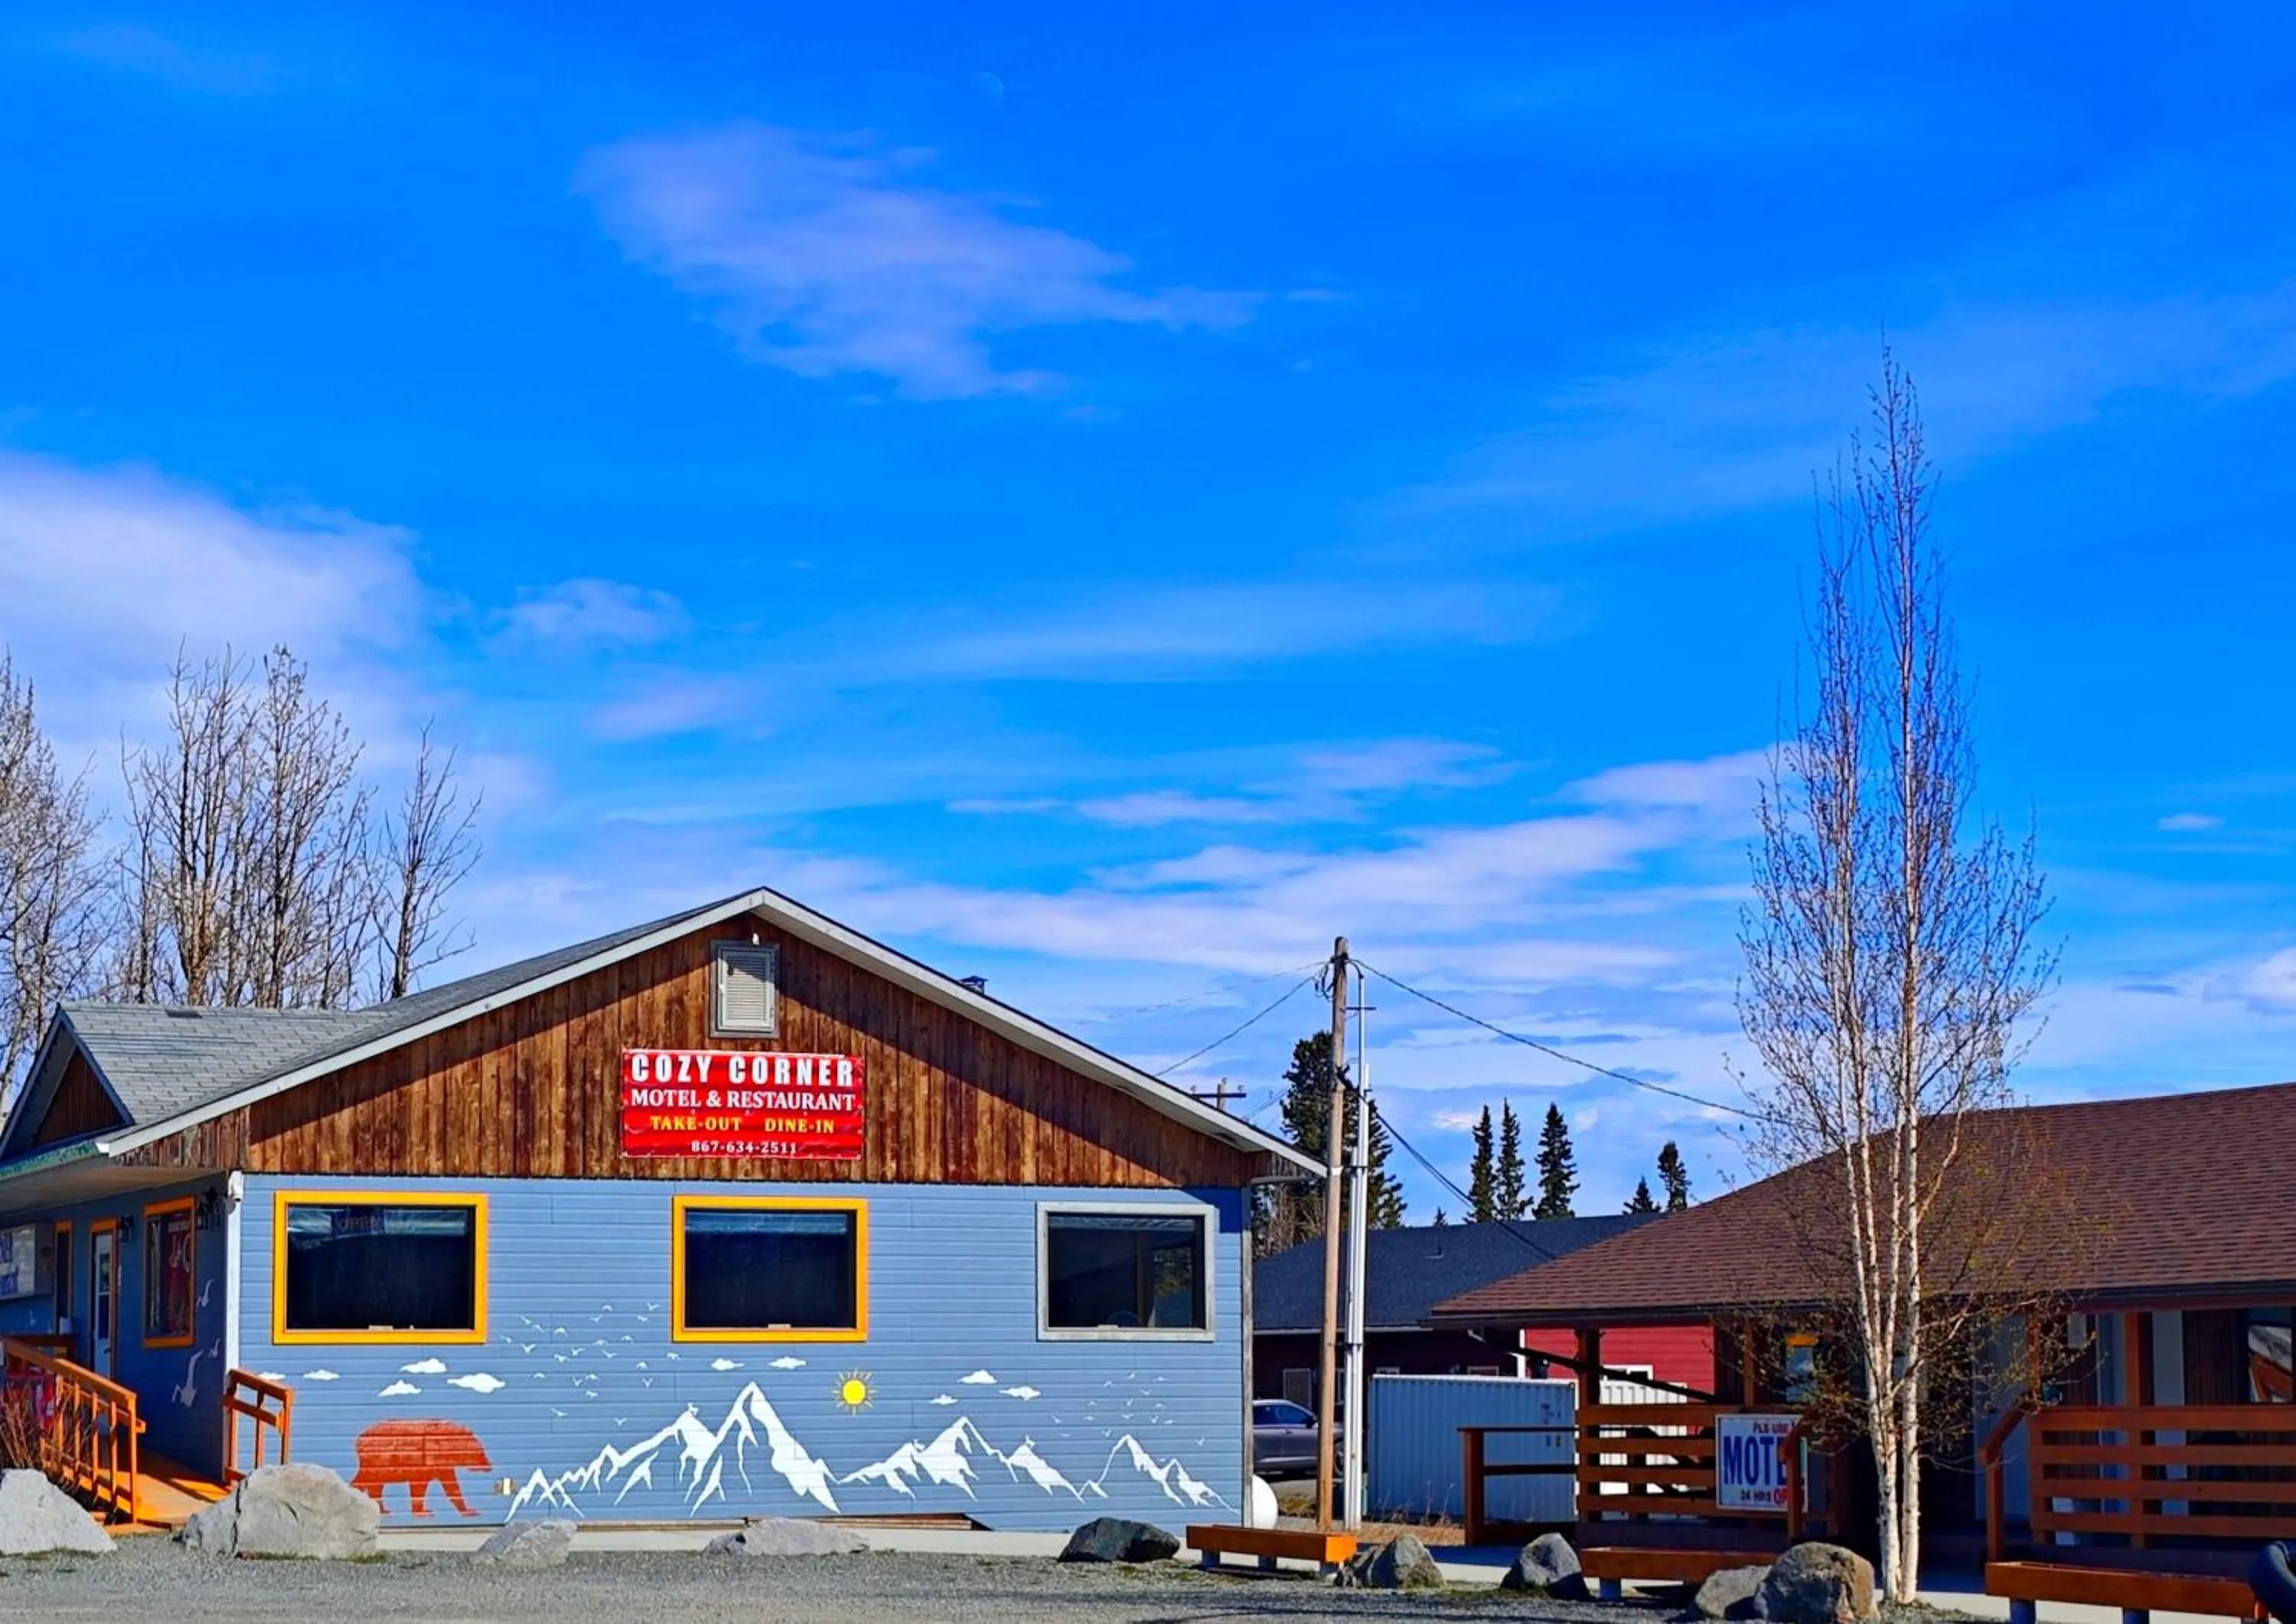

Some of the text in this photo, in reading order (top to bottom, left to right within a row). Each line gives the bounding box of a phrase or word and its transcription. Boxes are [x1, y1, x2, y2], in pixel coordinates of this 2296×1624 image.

[631, 1053, 854, 1087] COZY CORNER
[631, 1089, 856, 1111] MOTEL & RESTAURANT
[650, 1116, 835, 1134] TAKE-OUT DINE-IN
[691, 1140, 797, 1155] 867-634-2511
[1723, 1436, 1805, 1485] MOTE
